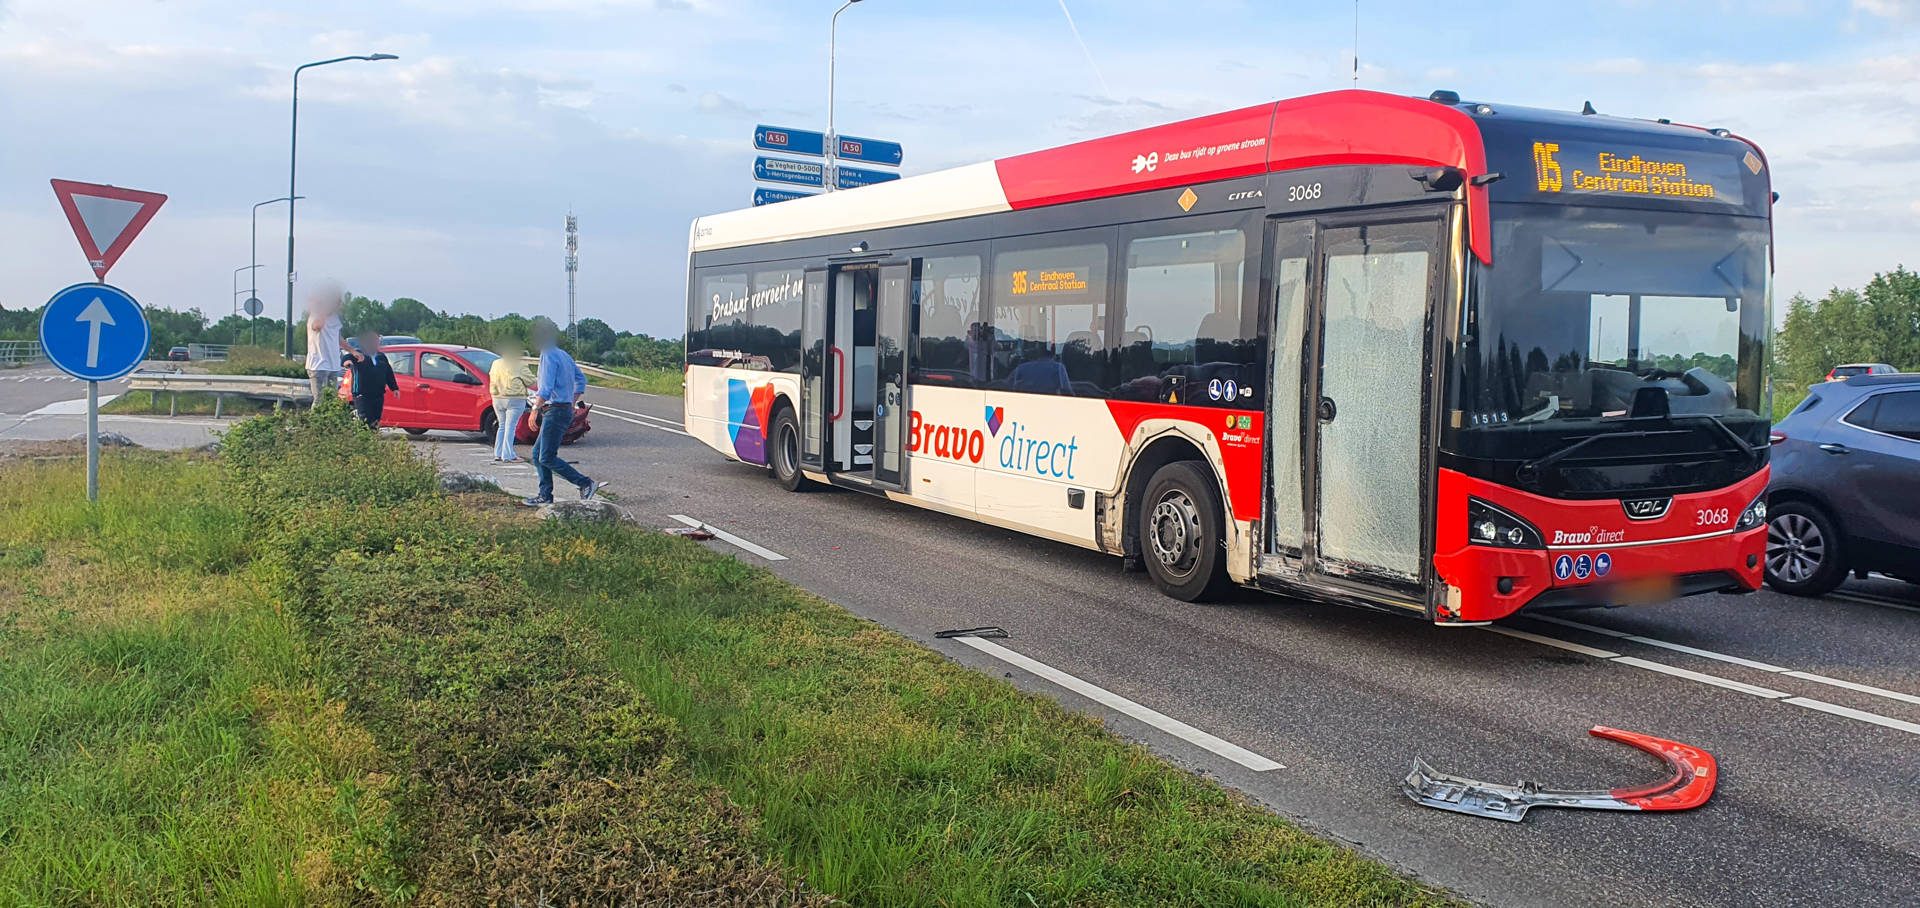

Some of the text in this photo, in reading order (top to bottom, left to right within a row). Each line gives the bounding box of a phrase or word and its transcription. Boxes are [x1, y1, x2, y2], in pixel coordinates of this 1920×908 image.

[1180, 150, 1192, 159] bus
[1208, 146, 1216, 155] op
[1217, 142, 1240, 154] groene
[1241, 138, 1266, 149] stroom
[1599, 152, 1687, 177] Eindhoven
[1288, 183, 1322, 202] 3068
[1572, 170, 1714, 198] Centraal Station
[1228, 190, 1263, 200] CITEA
[1012, 270, 1076, 295] 305 Eindhoven
[1030, 280, 1086, 292] Centraal Station
[713, 286, 749, 321] Brabant
[751, 273, 791, 309] vervoert
[905, 410, 1078, 480] Bravo direct
[1222, 431, 1241, 442] Bravo
[1696, 508, 1729, 525] 3068
[1552, 528, 1624, 544] Bravo direct
